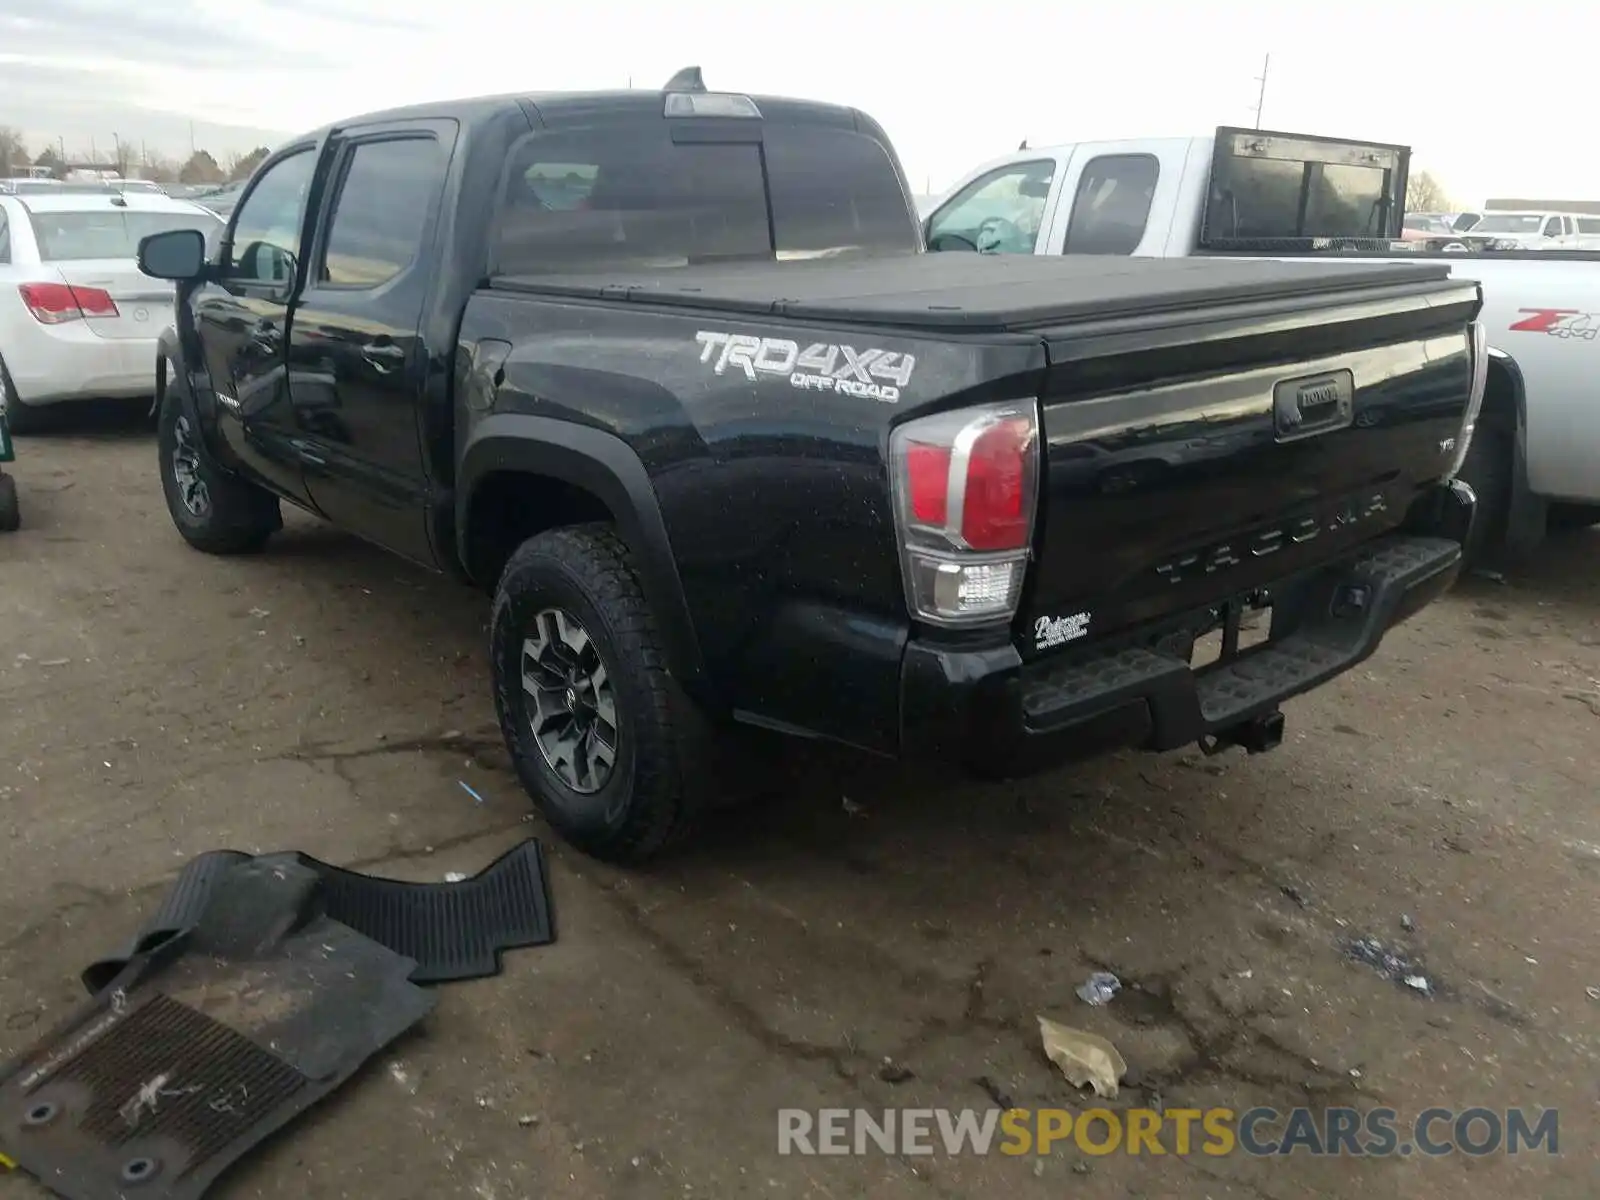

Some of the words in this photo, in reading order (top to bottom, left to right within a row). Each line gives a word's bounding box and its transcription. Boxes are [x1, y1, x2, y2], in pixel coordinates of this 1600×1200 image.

[695, 330, 799, 382] TRD
[797, 342, 915, 387] 4X4
[790, 372, 833, 391] OFF
[834, 378, 900, 404] ROAD
[1156, 492, 1388, 584] TACOMA
